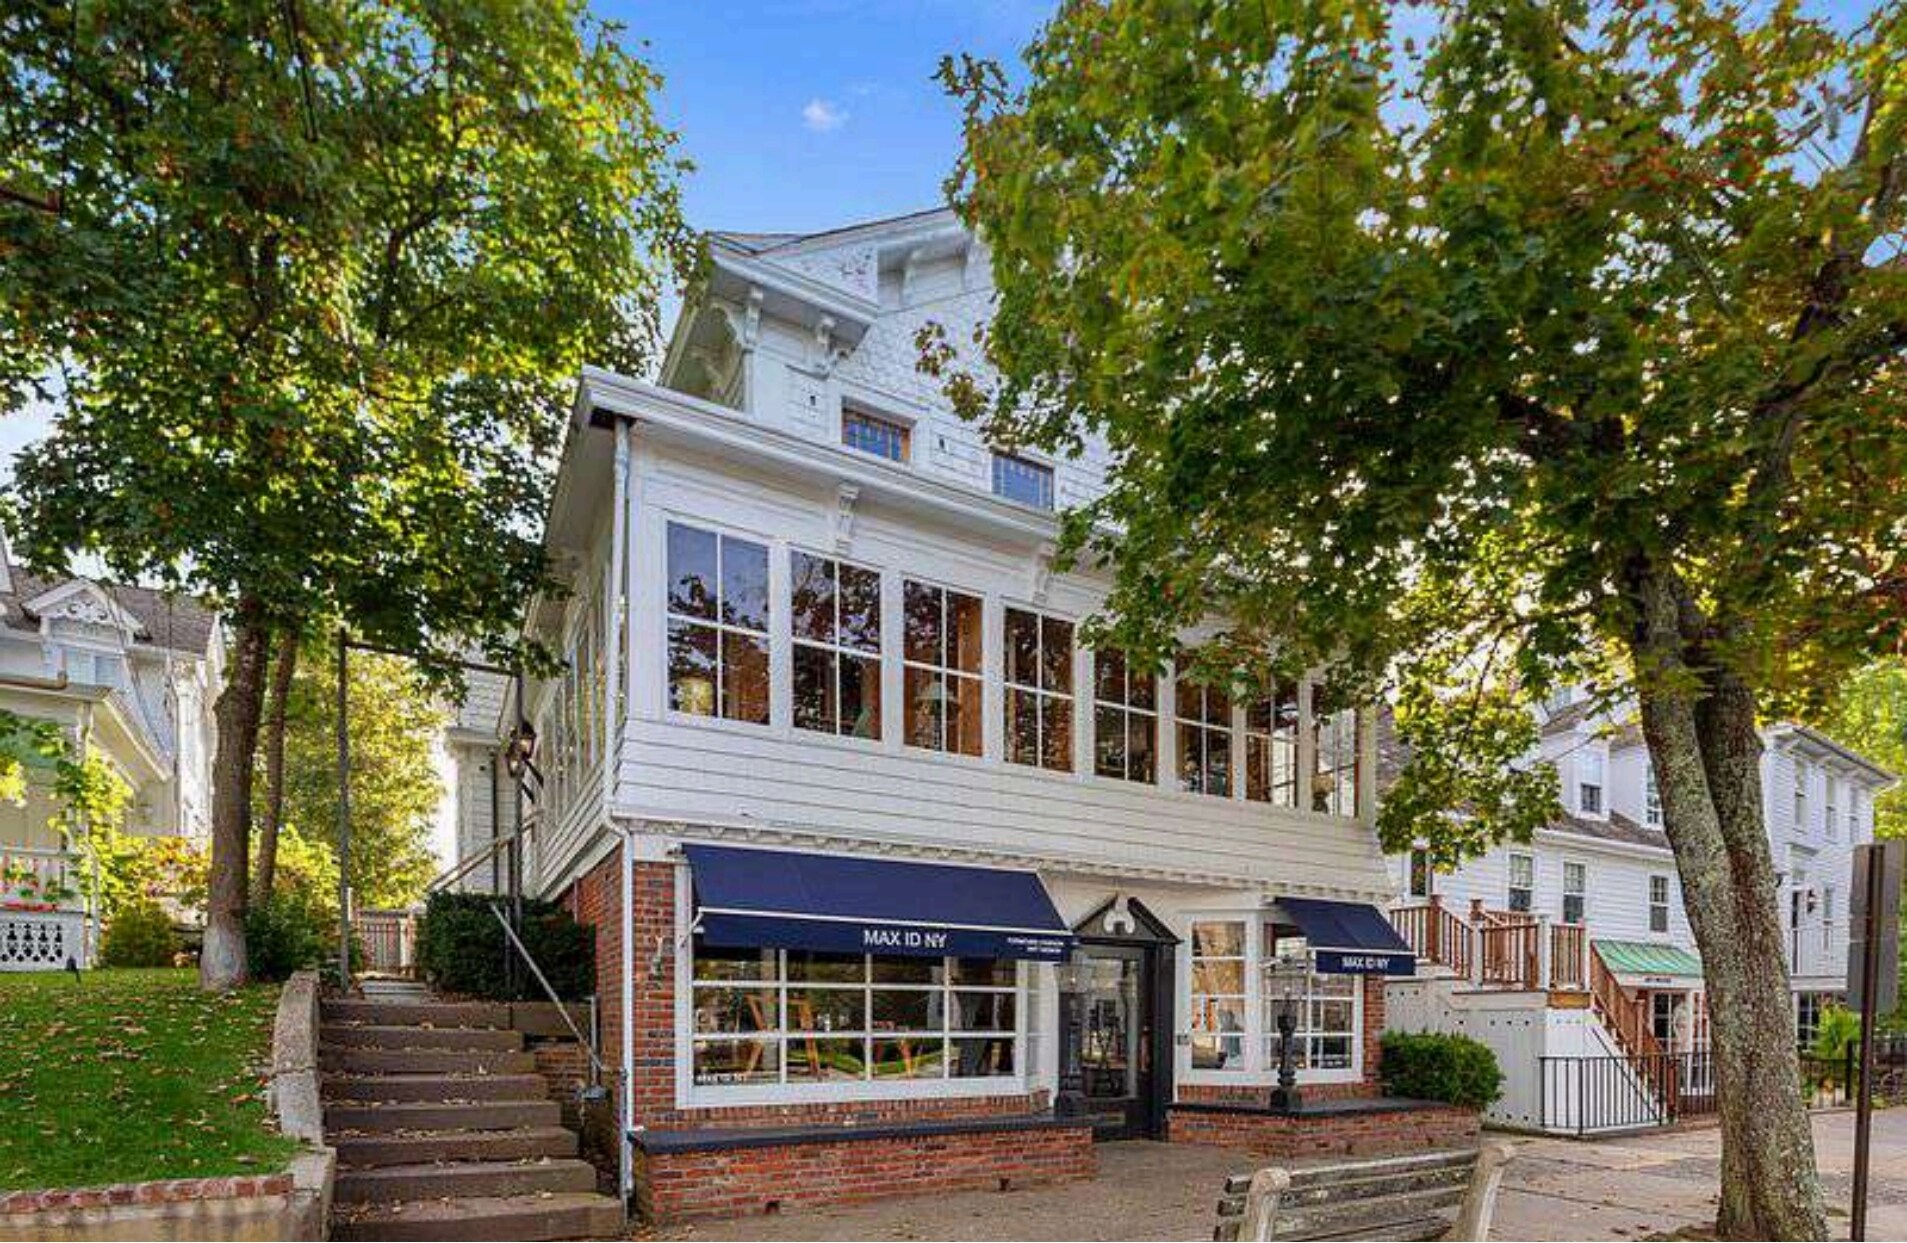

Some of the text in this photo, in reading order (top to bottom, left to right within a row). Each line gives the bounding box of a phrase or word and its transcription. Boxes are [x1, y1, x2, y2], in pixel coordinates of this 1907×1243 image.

[864, 930, 947, 949] MAX ID NY
[1342, 955, 1364, 969] MAX
